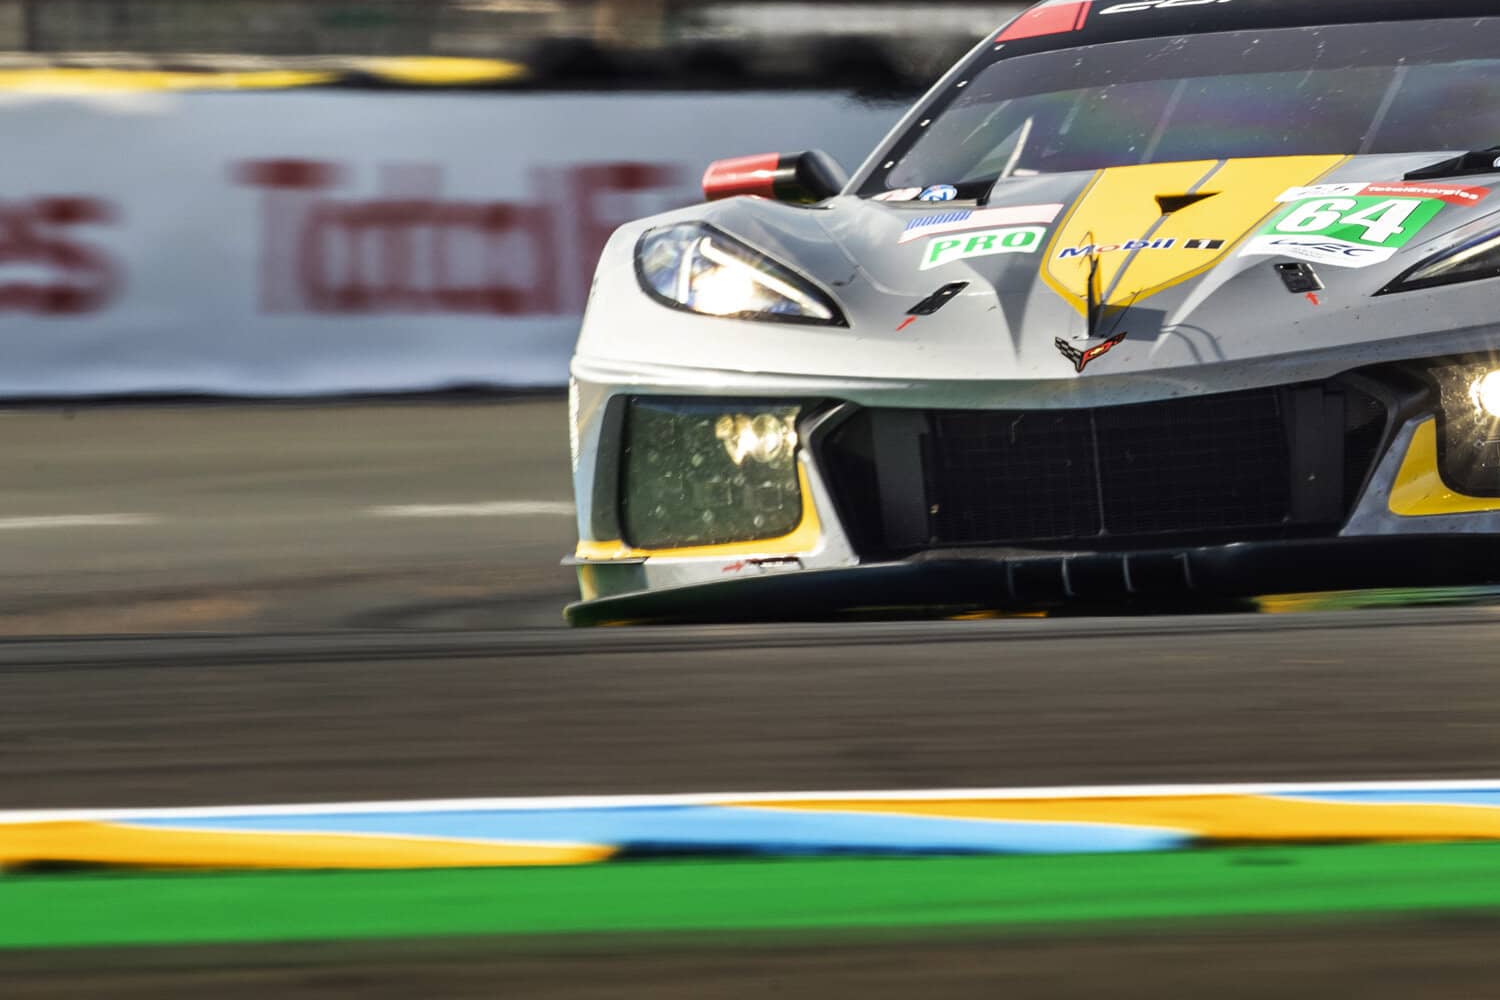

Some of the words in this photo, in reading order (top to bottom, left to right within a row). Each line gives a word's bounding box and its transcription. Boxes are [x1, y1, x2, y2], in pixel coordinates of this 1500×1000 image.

[1367, 185, 1480, 201] TotalEnergies
[1275, 198, 1424, 244] 64
[929, 231, 1036, 263] PRO
[1059, 238, 1176, 259] Mobil
[1270, 238, 1374, 258] WEC
